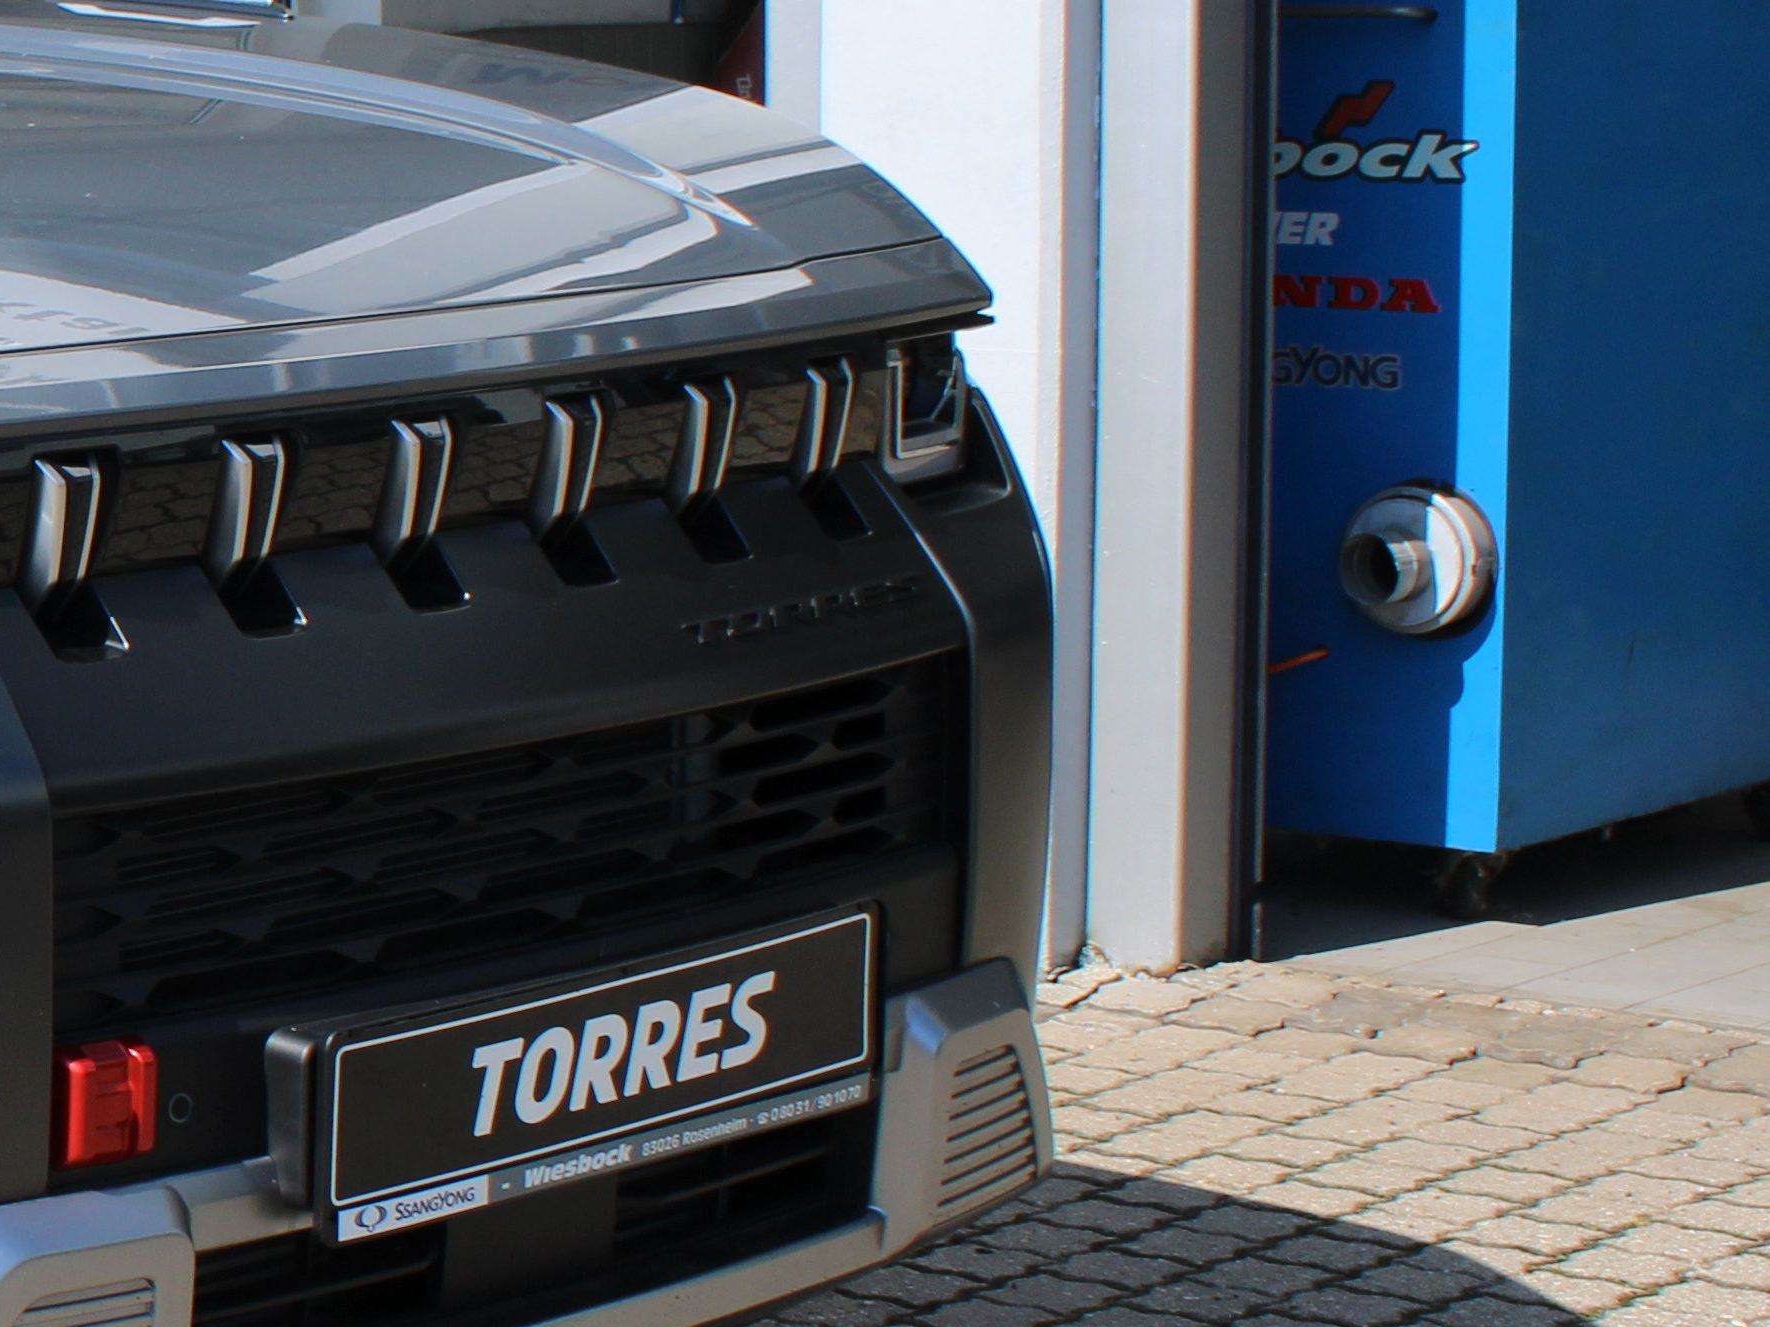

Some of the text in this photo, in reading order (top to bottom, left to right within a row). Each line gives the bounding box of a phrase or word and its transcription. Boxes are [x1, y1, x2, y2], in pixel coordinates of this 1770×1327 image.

[1274, 211, 1339, 246] ER
[472, 970, 775, 1137] TORRES
[523, 1141, 634, 1190] Wiesbock
[641, 1133, 681, 1157] 83026
[681, 1117, 748, 1147] Rosenheim
